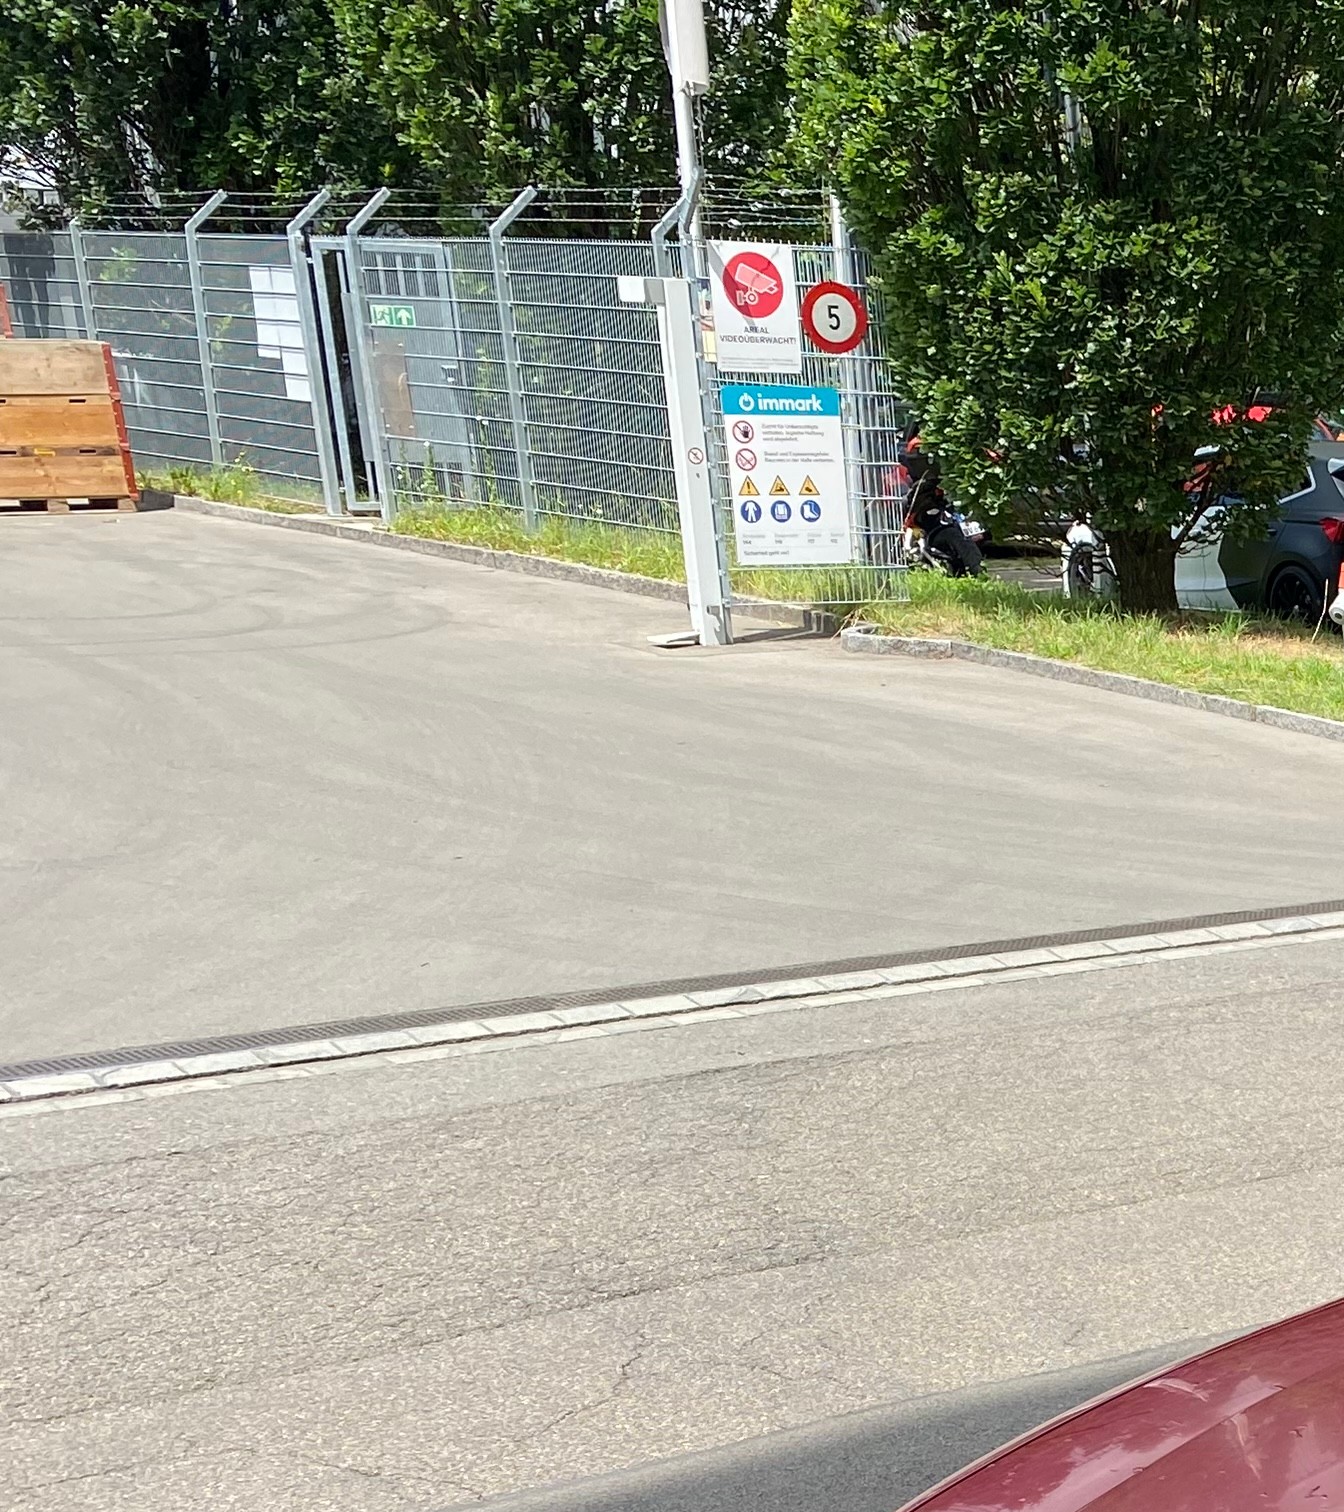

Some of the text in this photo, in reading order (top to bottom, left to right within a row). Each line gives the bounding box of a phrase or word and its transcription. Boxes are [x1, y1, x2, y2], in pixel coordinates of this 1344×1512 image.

[827, 305, 840, 330] 5
[743, 326, 769, 334] AREAL
[719, 334, 797, 345] VIDEOÜBERWACHT!
[757, 392, 824, 412] immark
